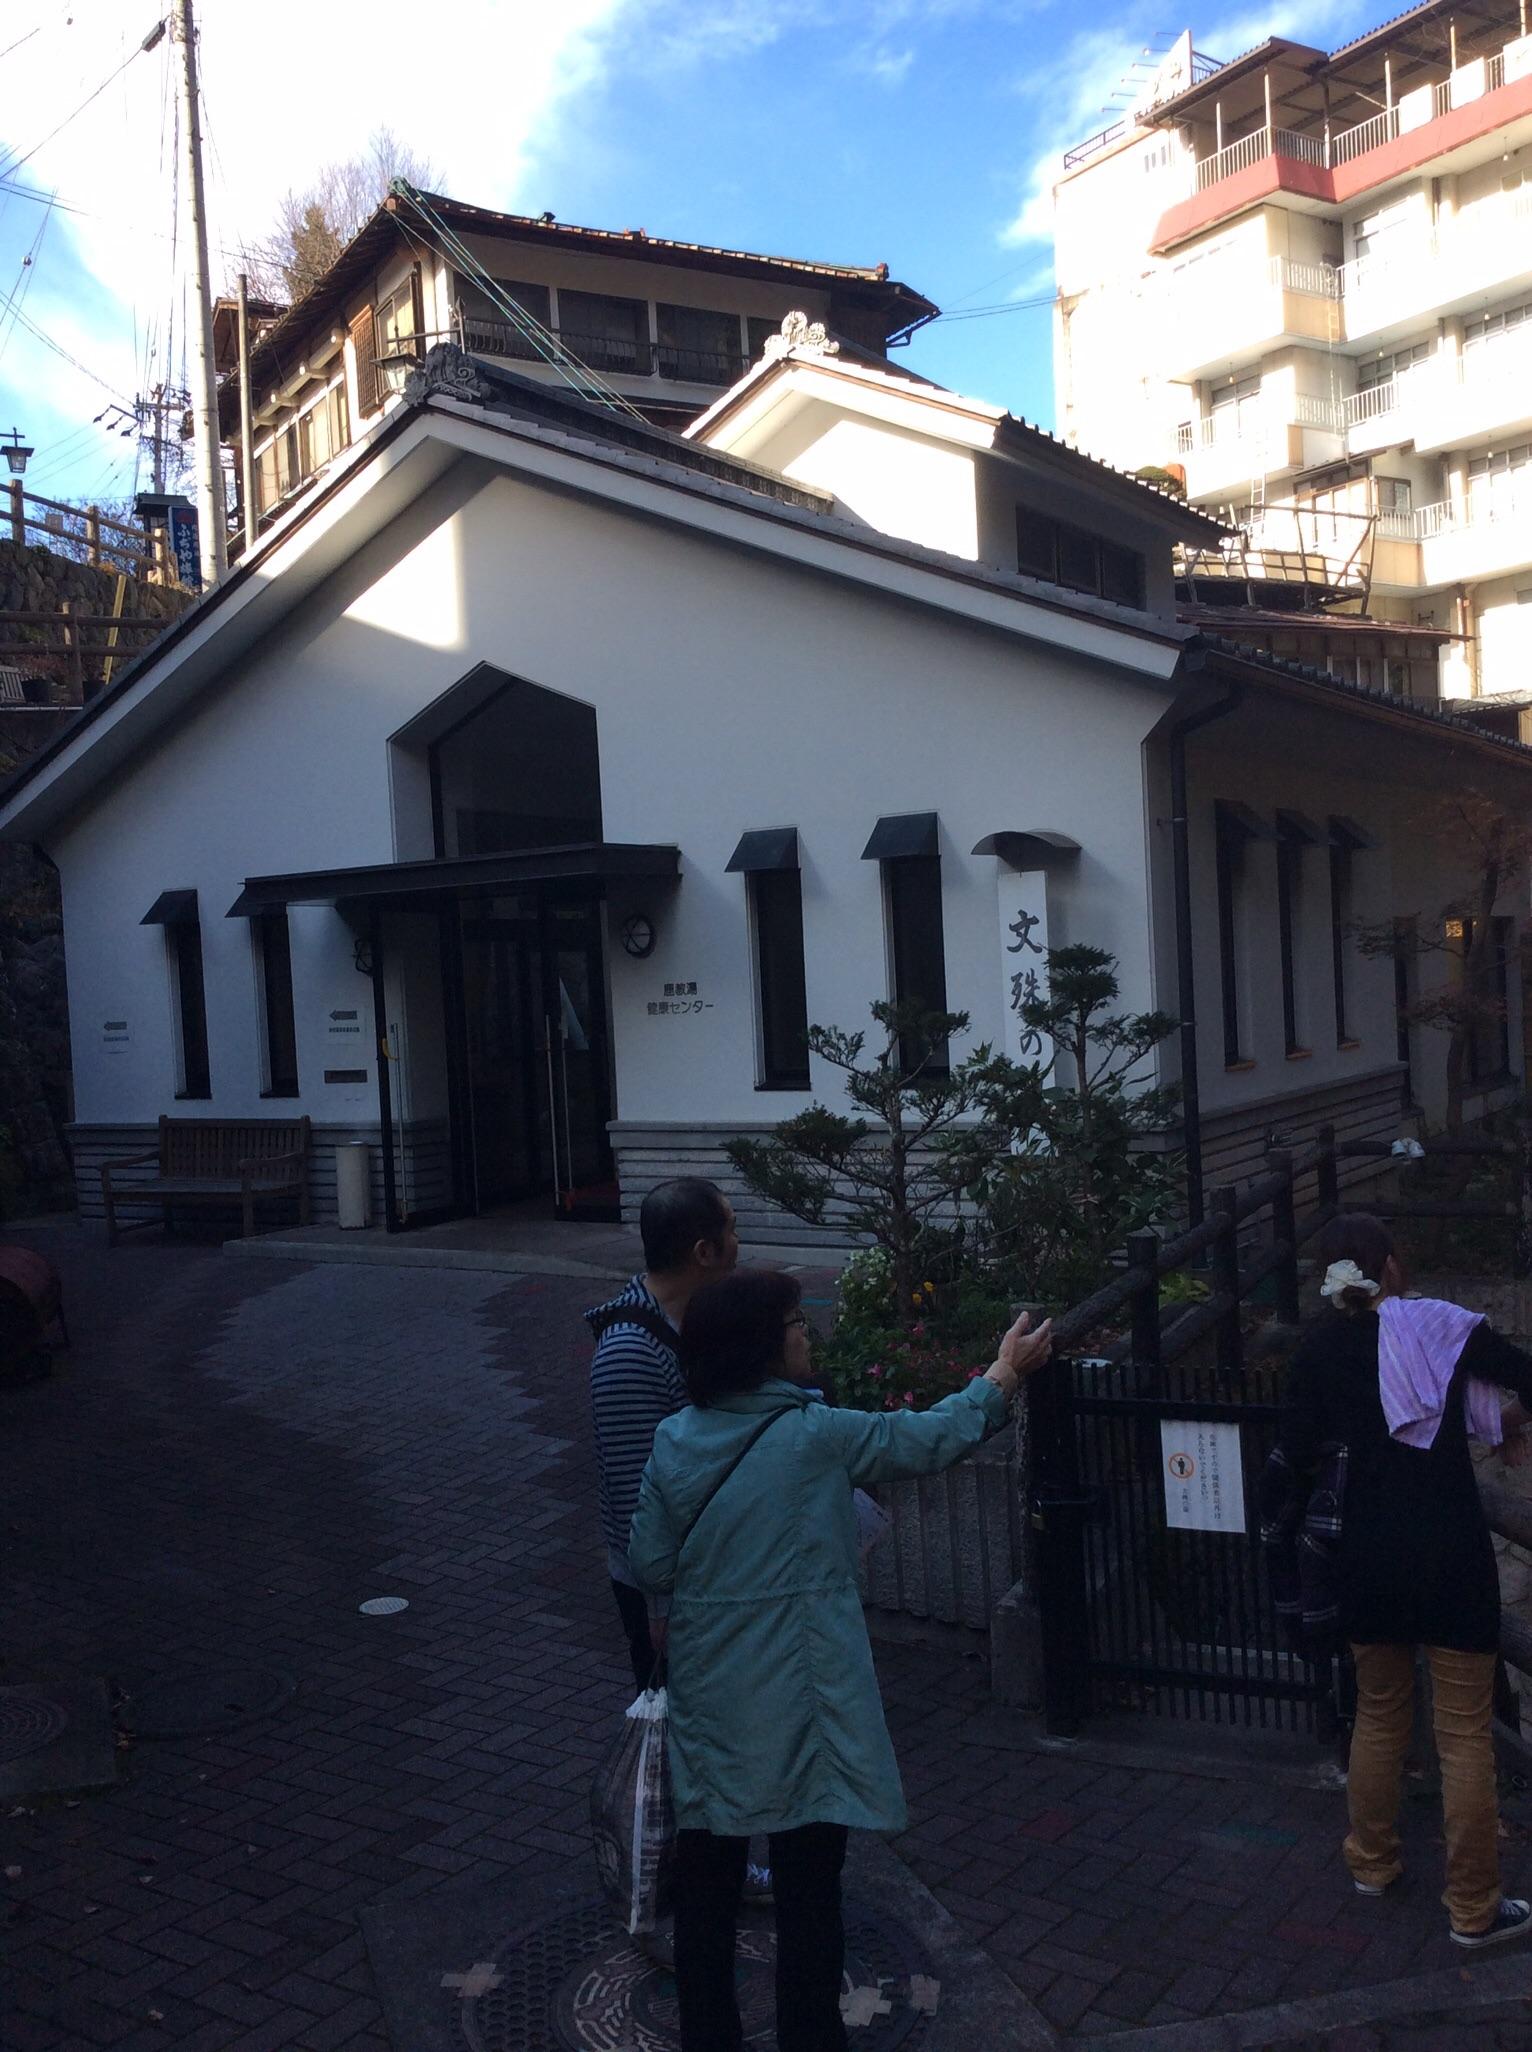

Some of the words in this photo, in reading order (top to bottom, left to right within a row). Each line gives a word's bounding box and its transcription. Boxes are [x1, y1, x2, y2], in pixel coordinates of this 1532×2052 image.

[646, 1000, 715, 1016] 健康センター
